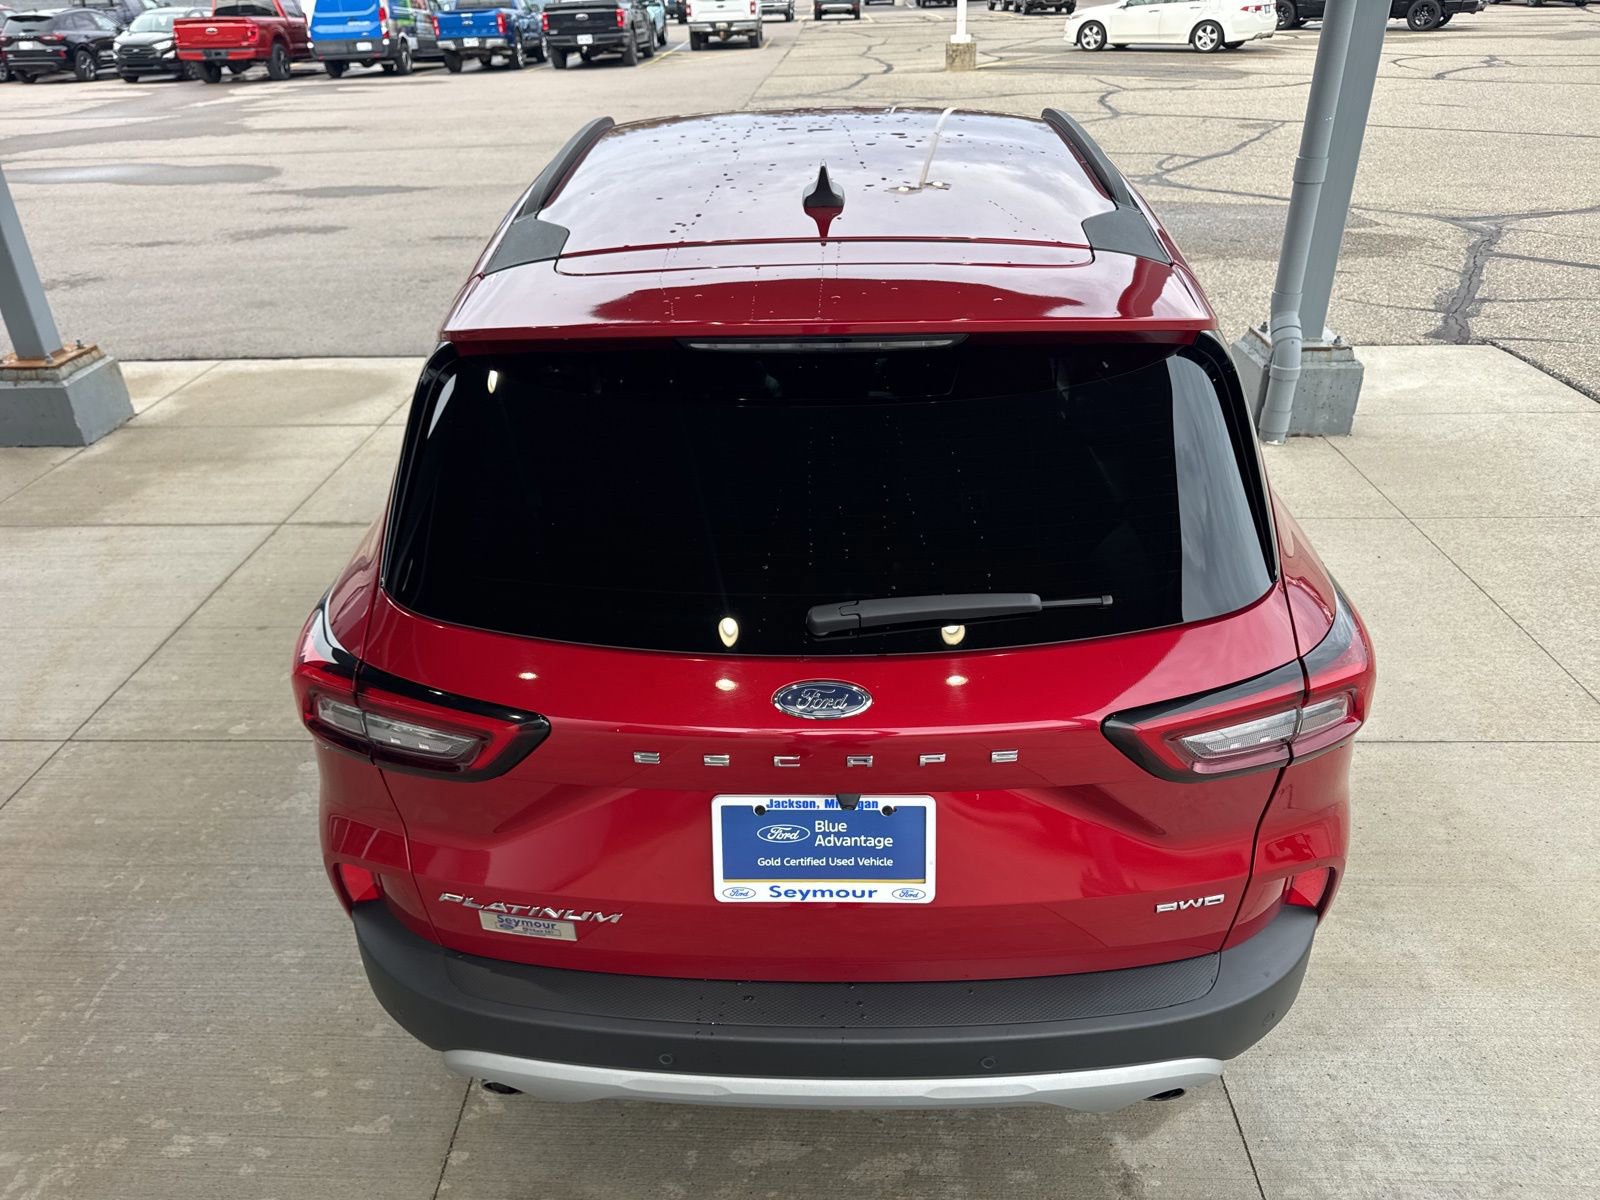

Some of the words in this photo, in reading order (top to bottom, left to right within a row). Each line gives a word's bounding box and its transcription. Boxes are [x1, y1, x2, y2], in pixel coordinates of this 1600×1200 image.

[796, 688, 849, 709] Ford
[633, 749, 1019, 768] ESCAPE
[766, 798, 820, 810] Jackson,
[824, 798, 879, 810] Migan
[767, 826, 800, 840] Ford
[814, 820, 848, 833] Blue
[814, 834, 893, 849] Advantage
[757, 857, 781, 867] Gold
[783, 857, 826, 867] Certified
[828, 857, 855, 867] Used
[857, 857, 894, 867] Vehicle
[768, 885, 878, 901] Seymour
[438, 893, 624, 924] PLATINUM
[1155, 893, 1226, 914] AWD
[496, 914, 557, 930] Seymour
